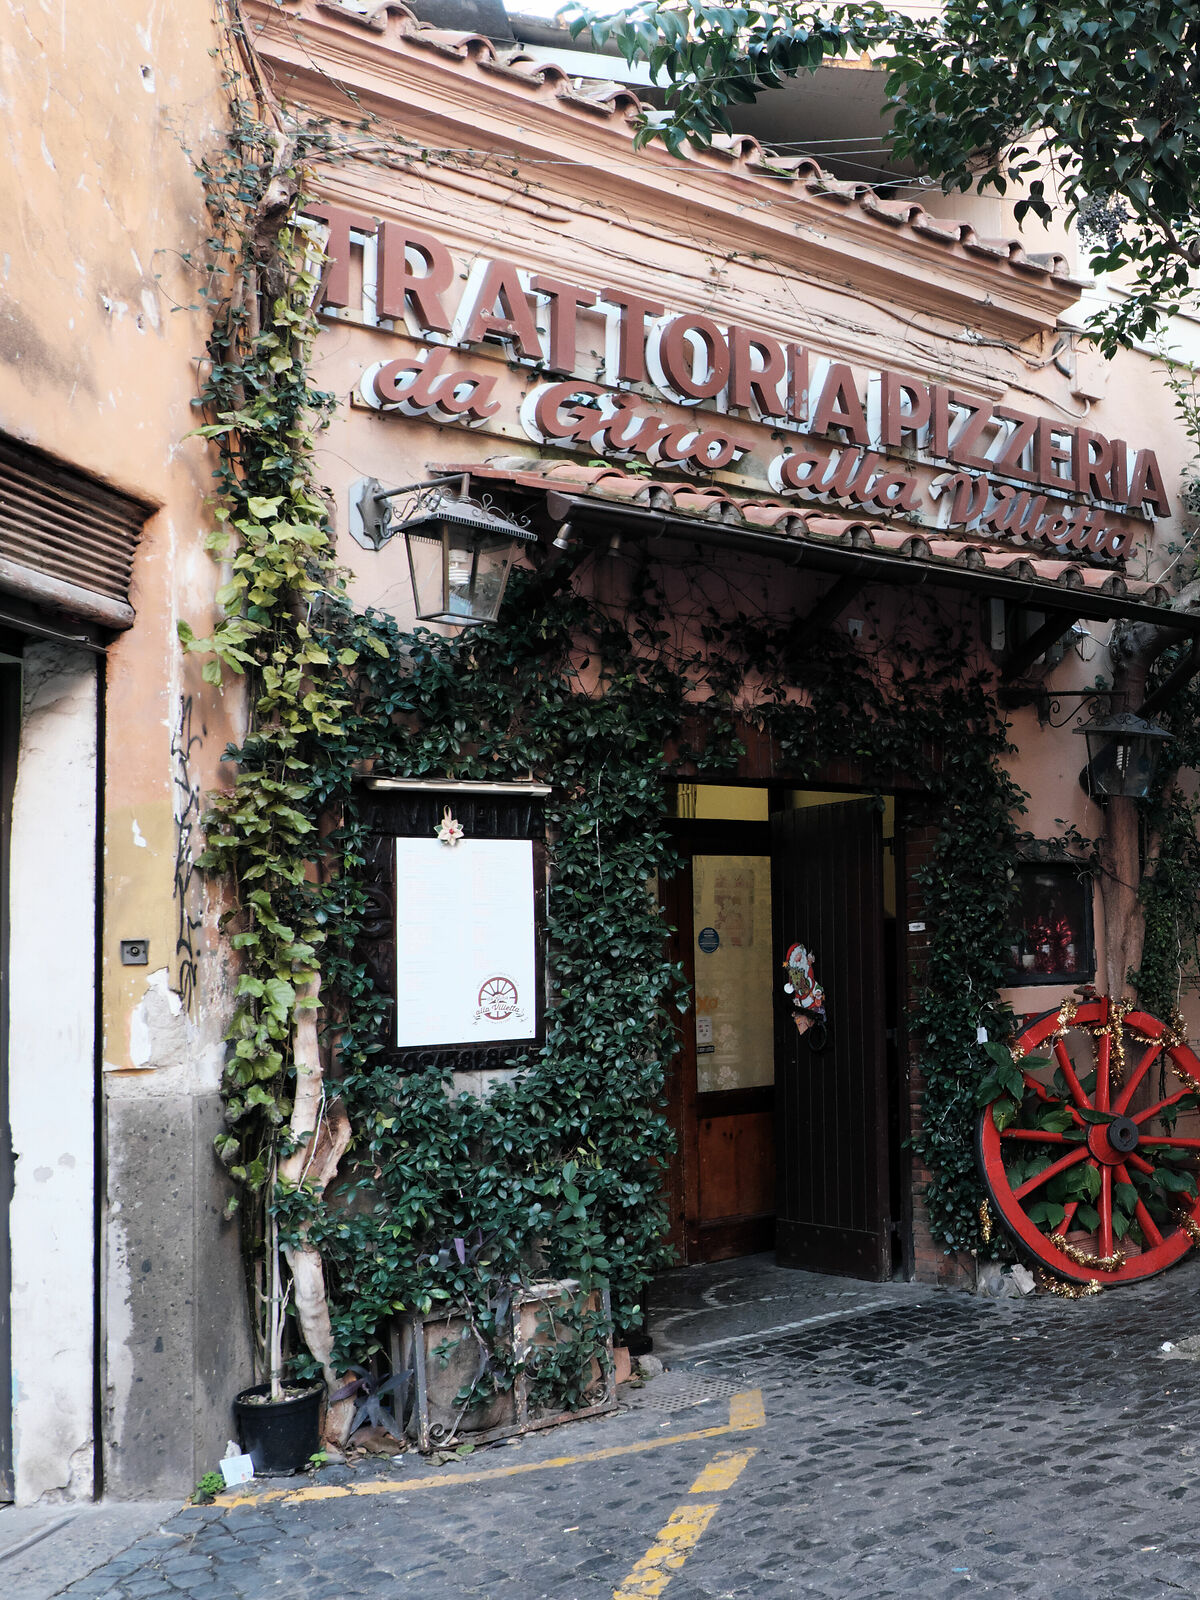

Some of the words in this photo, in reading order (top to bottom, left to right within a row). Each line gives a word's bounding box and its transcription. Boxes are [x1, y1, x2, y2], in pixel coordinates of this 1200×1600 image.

[298, 202, 870, 446] TRATTORIA
[881, 370, 1171, 518] PIZZERIA
[372, 346, 501, 421] da
[534, 380, 757, 470] Gino
[780, 447, 923, 513] alla
[941, 472, 1138, 562] Villetta
[492, 1004, 520, 1013] Villetta
